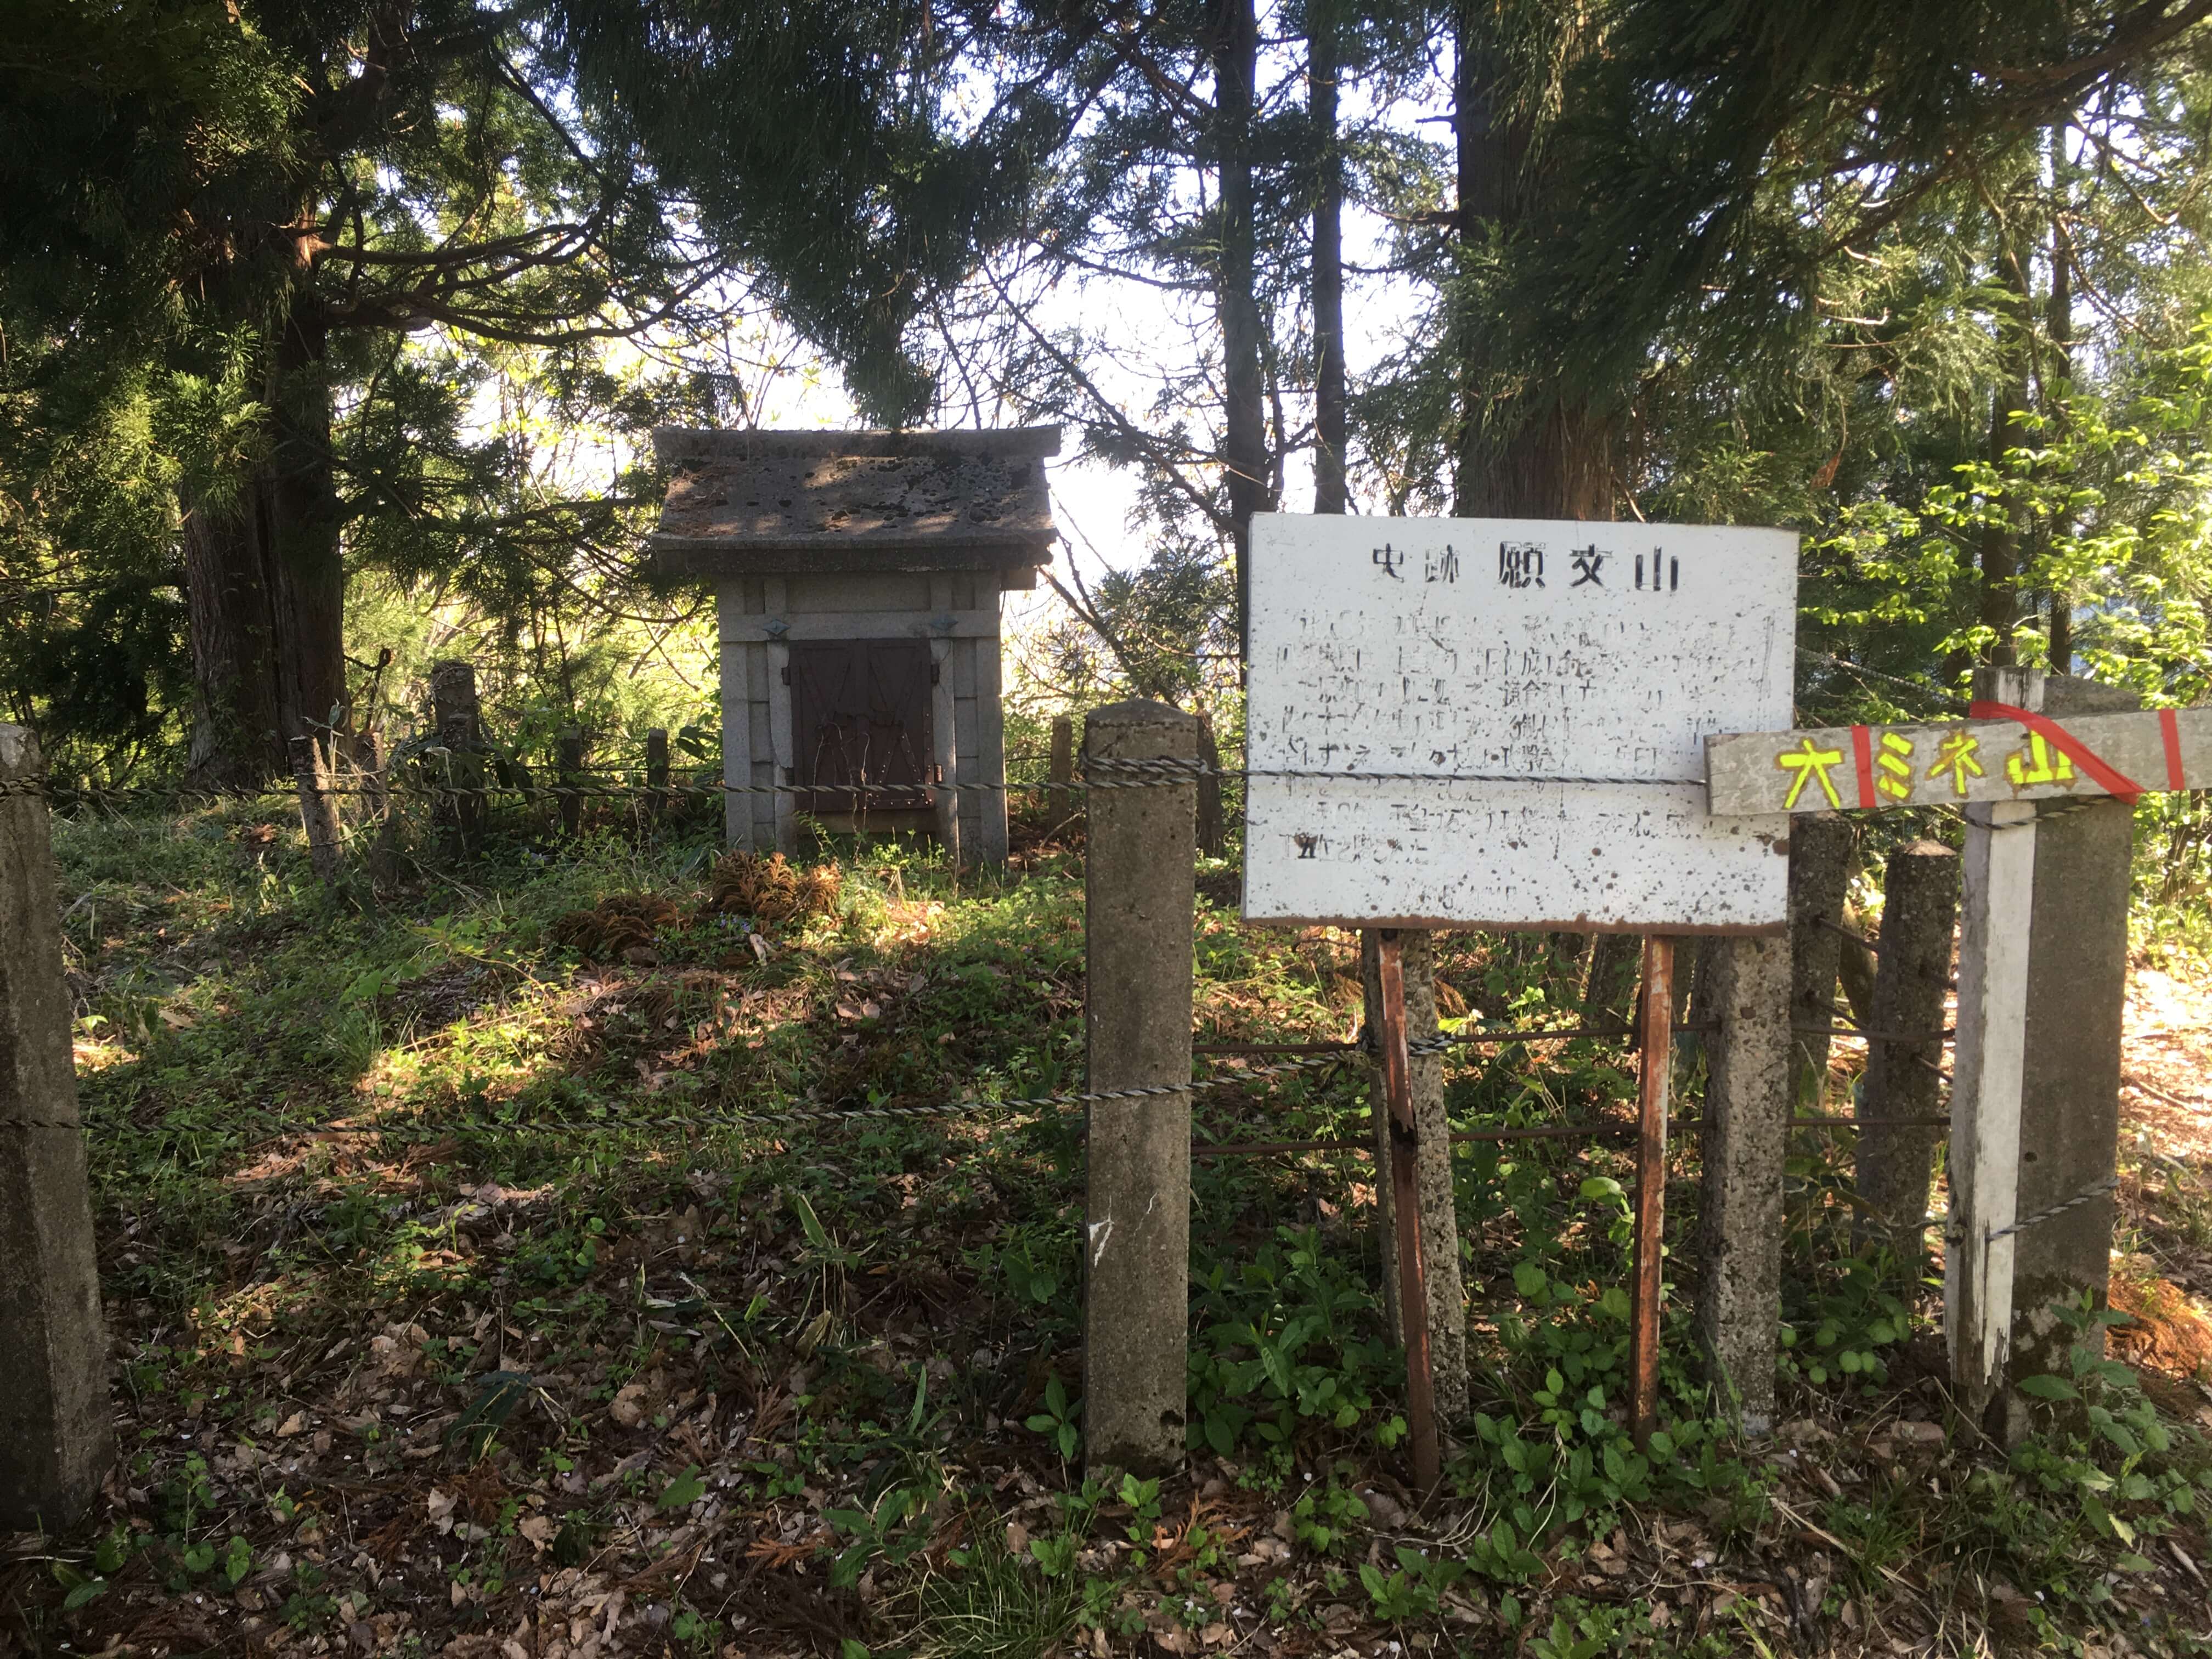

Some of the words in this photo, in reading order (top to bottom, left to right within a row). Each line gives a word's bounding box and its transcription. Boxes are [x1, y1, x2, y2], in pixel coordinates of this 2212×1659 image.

[1372, 543, 1460, 584] 史跡
[1498, 540, 1679, 591] 願文山
